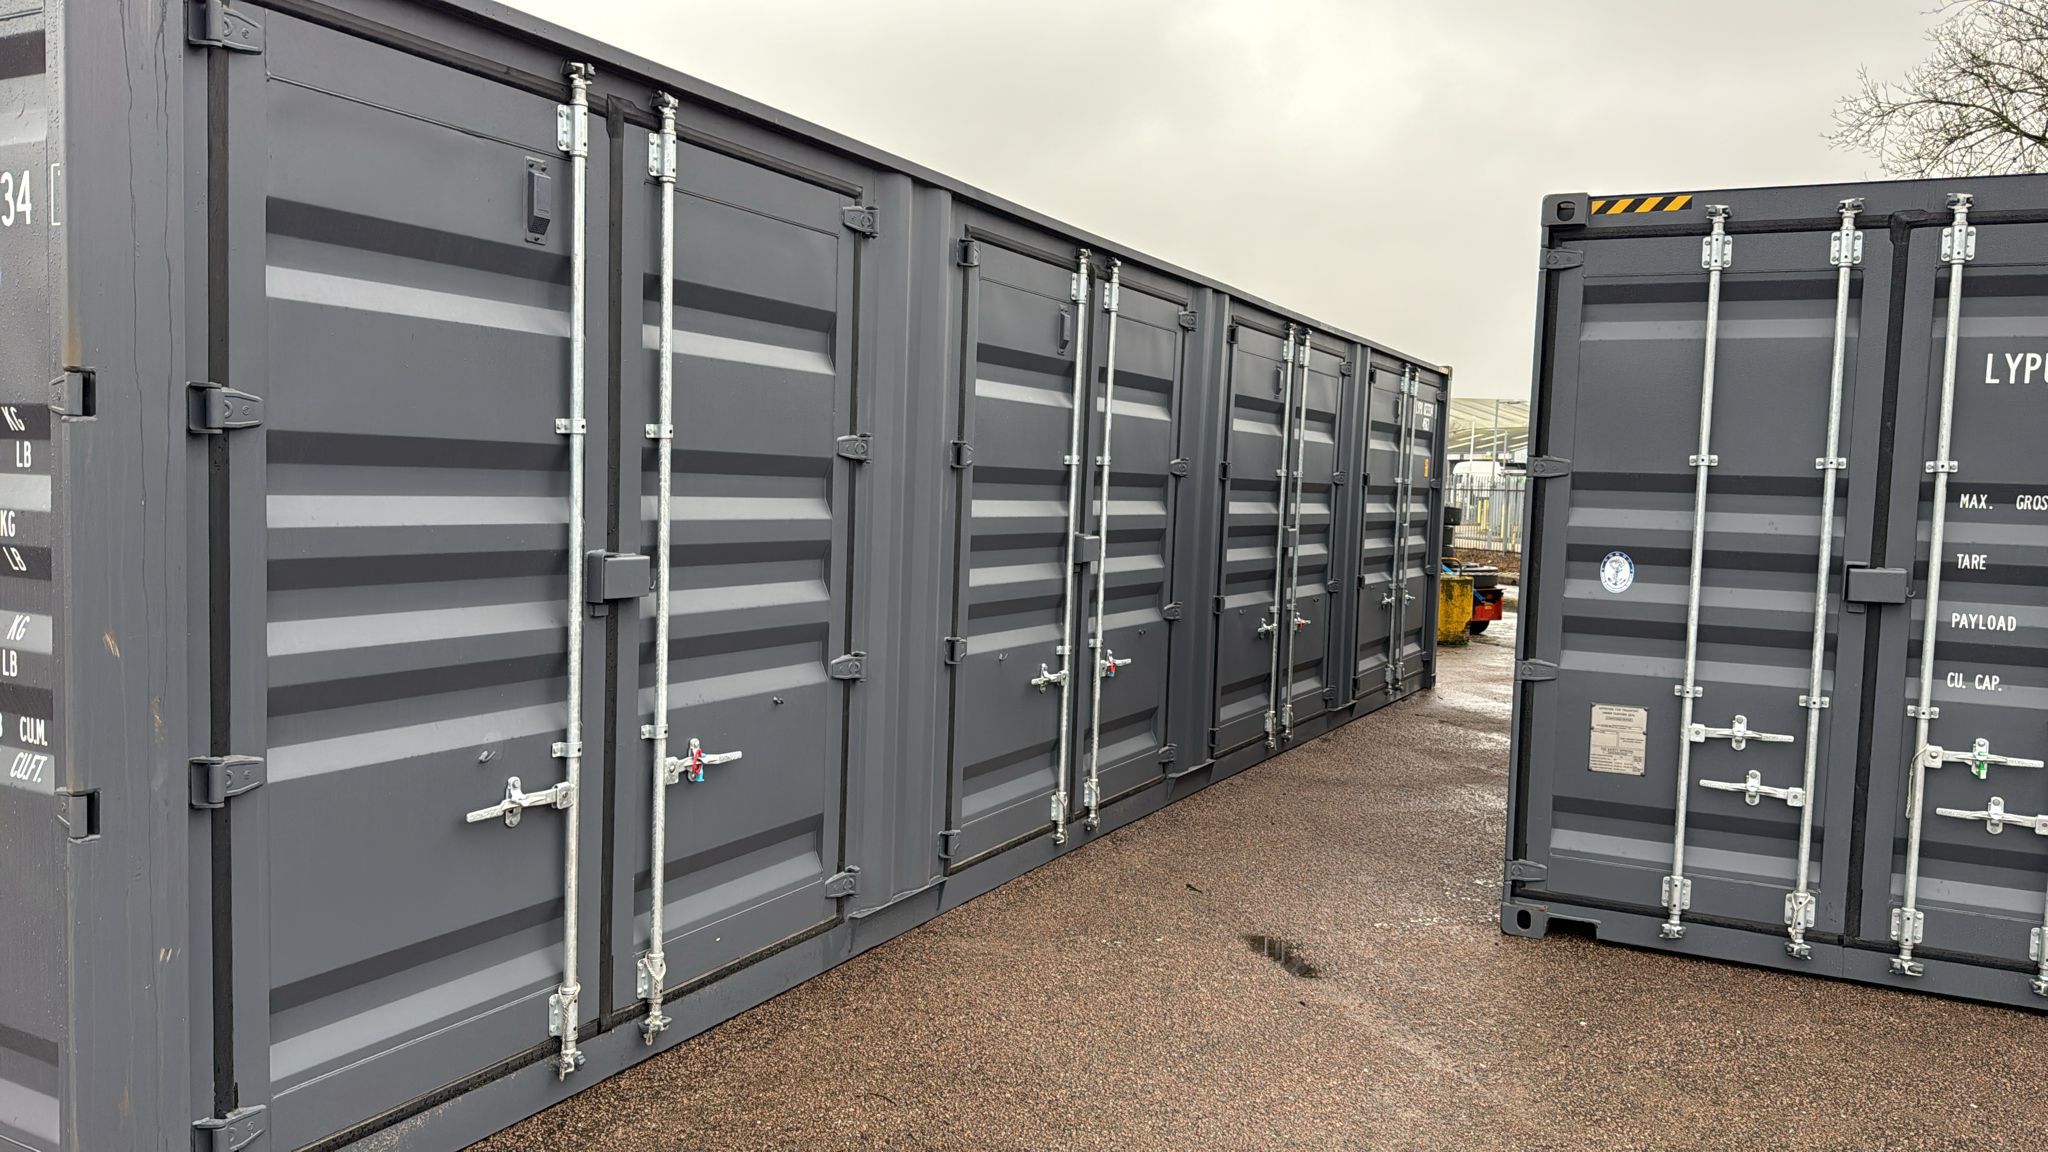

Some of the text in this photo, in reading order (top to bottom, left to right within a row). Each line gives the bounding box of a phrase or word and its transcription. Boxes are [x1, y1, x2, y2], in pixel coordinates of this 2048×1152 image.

[0, 406, 26, 432] KG
[16, 440, 32, 468] LB
[1959, 493, 1994, 510] MAX.
[0, 509, 16, 537] KG
[2, 546, 27, 572] LB
[1956, 553, 1988, 570] TARE
[6, 614, 30, 641] KG
[1951, 612, 2017, 632] PAYLOAD
[2, 650, 18, 677] LB
[1946, 671, 2003, 692] CU. CAP.
